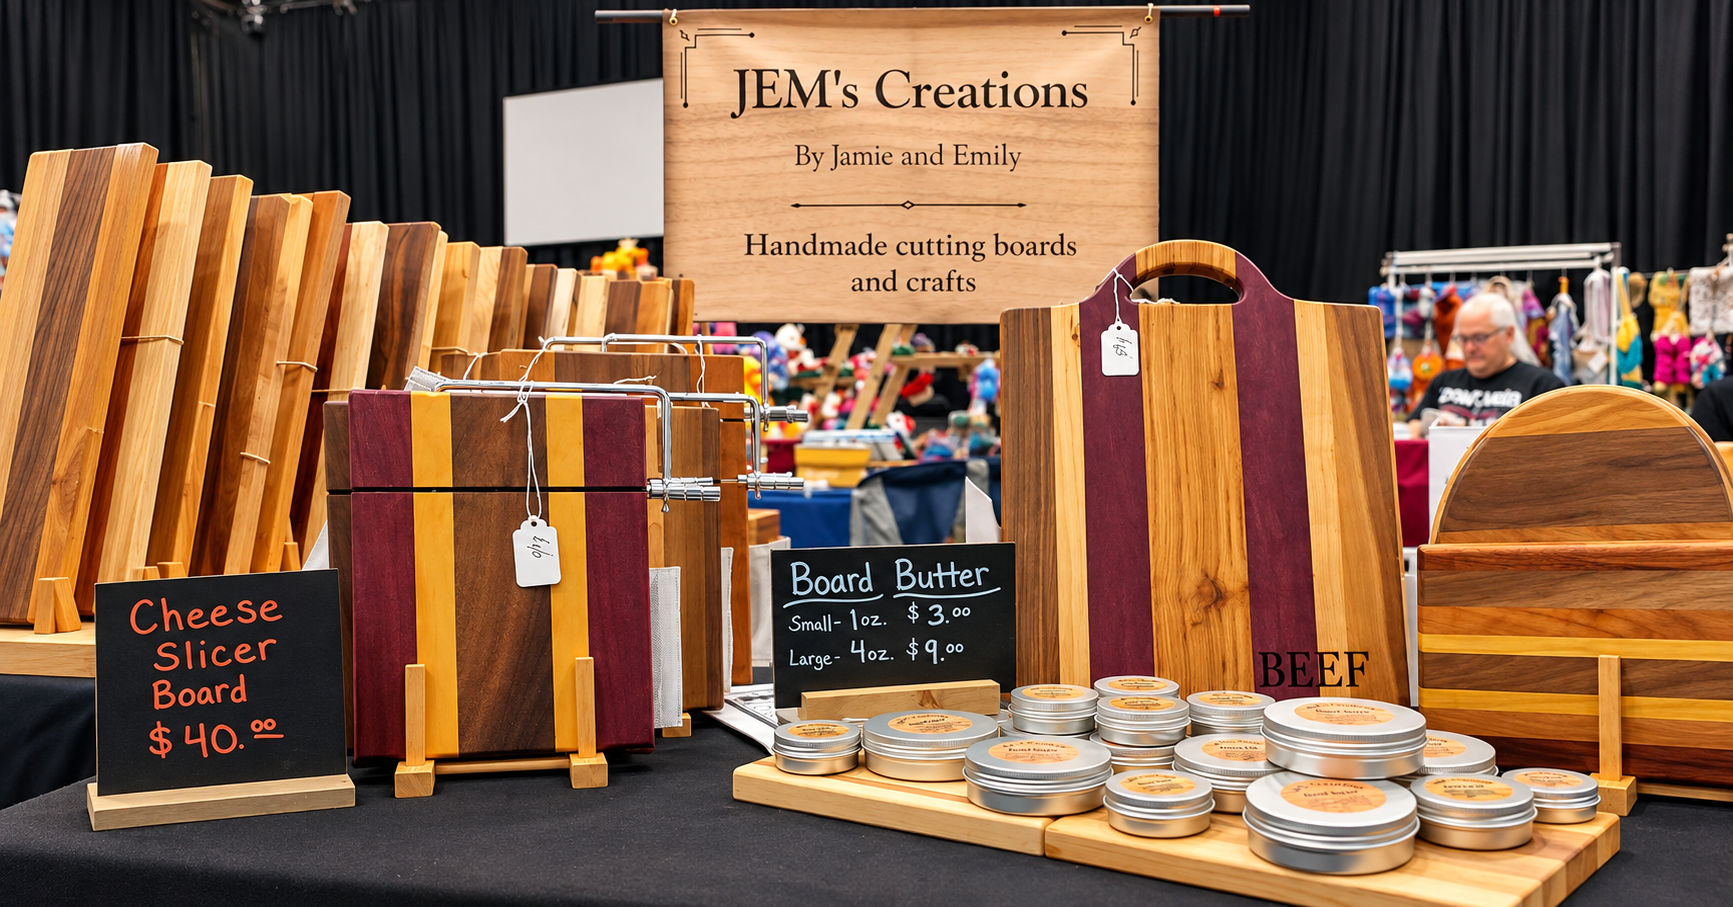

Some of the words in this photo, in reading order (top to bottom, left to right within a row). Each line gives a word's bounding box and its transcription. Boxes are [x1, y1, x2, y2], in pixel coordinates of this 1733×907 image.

[731, 68, 859, 119] JEM's
[875, 69, 1088, 109] Creations
[795, 145, 824, 172] By
[831, 144, 893, 172] Jamie
[902, 144, 944, 166] and
[954, 144, 1021, 172] Emily
[744, 233, 888, 256] Handmade
[896, 234, 986, 262] cutting
[994, 233, 1077, 256] boards
[851, 269, 898, 292] and
[906, 269, 976, 292] crafts
[791, 561, 874, 596] Board
[894, 558, 990, 591] Butter
[129, 597, 283, 635] Cheese
[153, 638, 277, 671] Slicer
[1258, 651, 1369, 688] BEEF
[152, 674, 247, 710] Board
